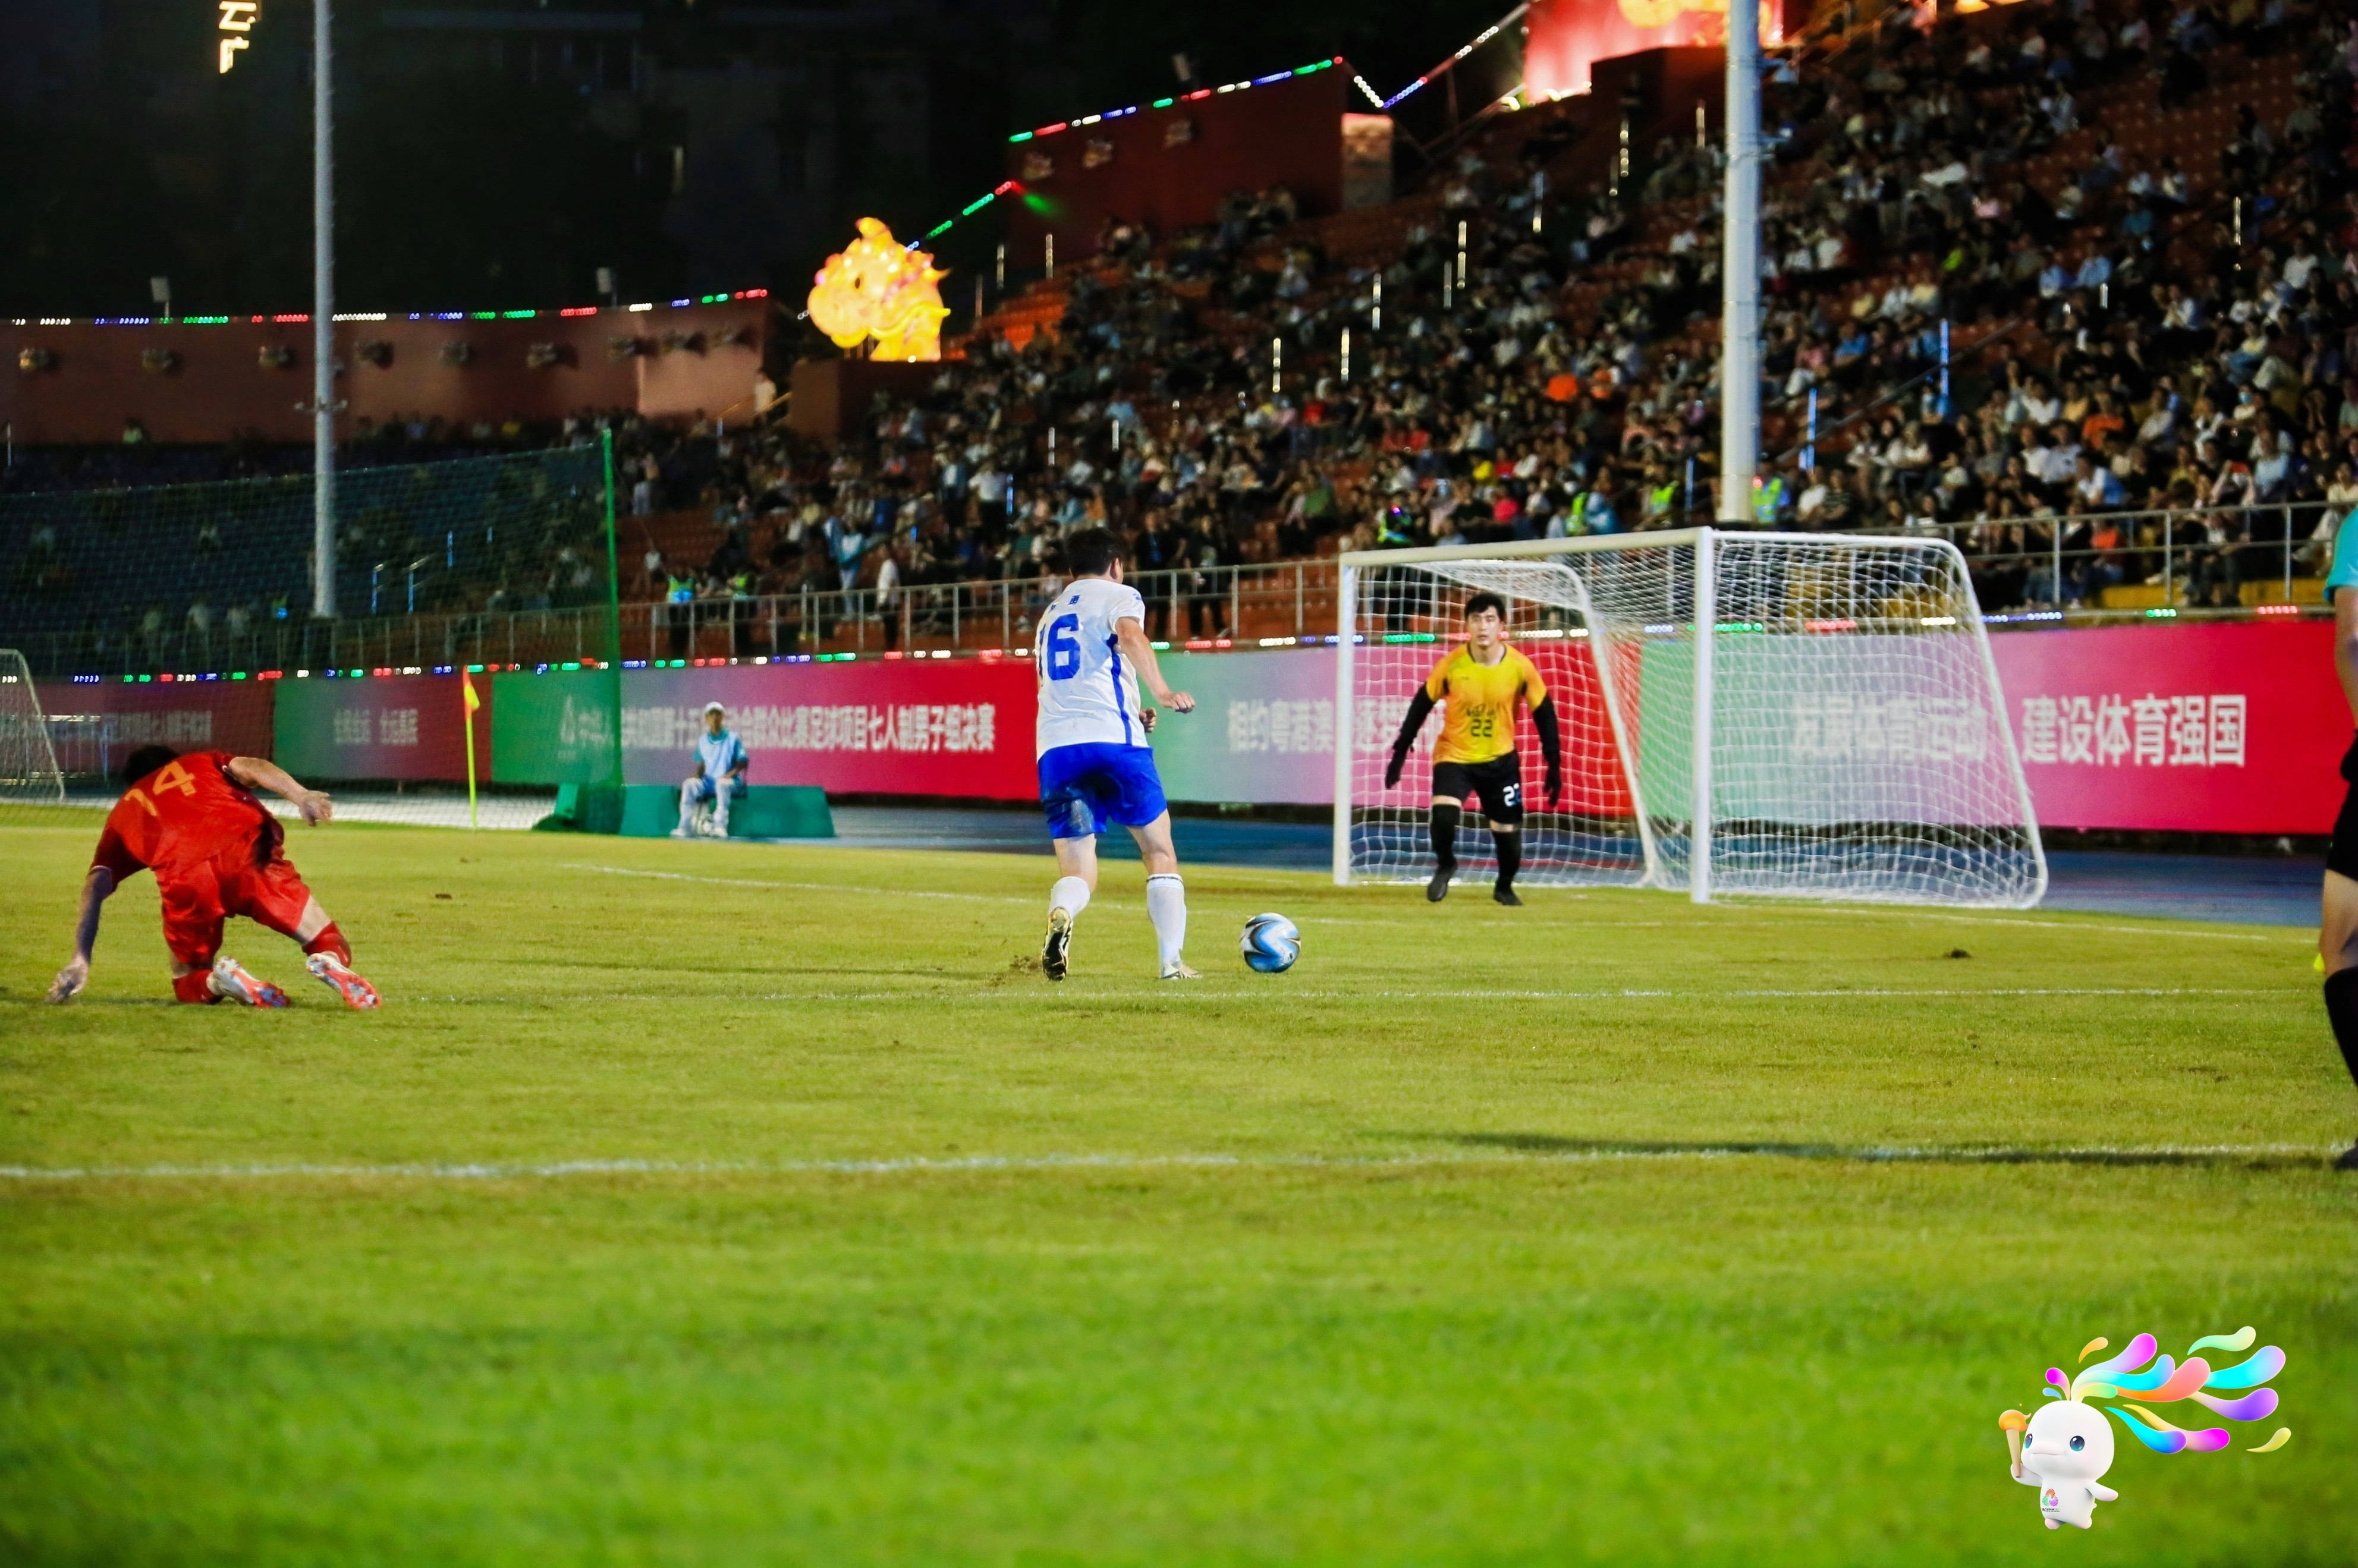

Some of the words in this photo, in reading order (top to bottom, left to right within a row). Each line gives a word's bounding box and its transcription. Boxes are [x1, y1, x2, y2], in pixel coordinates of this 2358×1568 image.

[1470, 719, 1493, 738] 22
[2021, 694, 2247, 767] 建设体育强国
